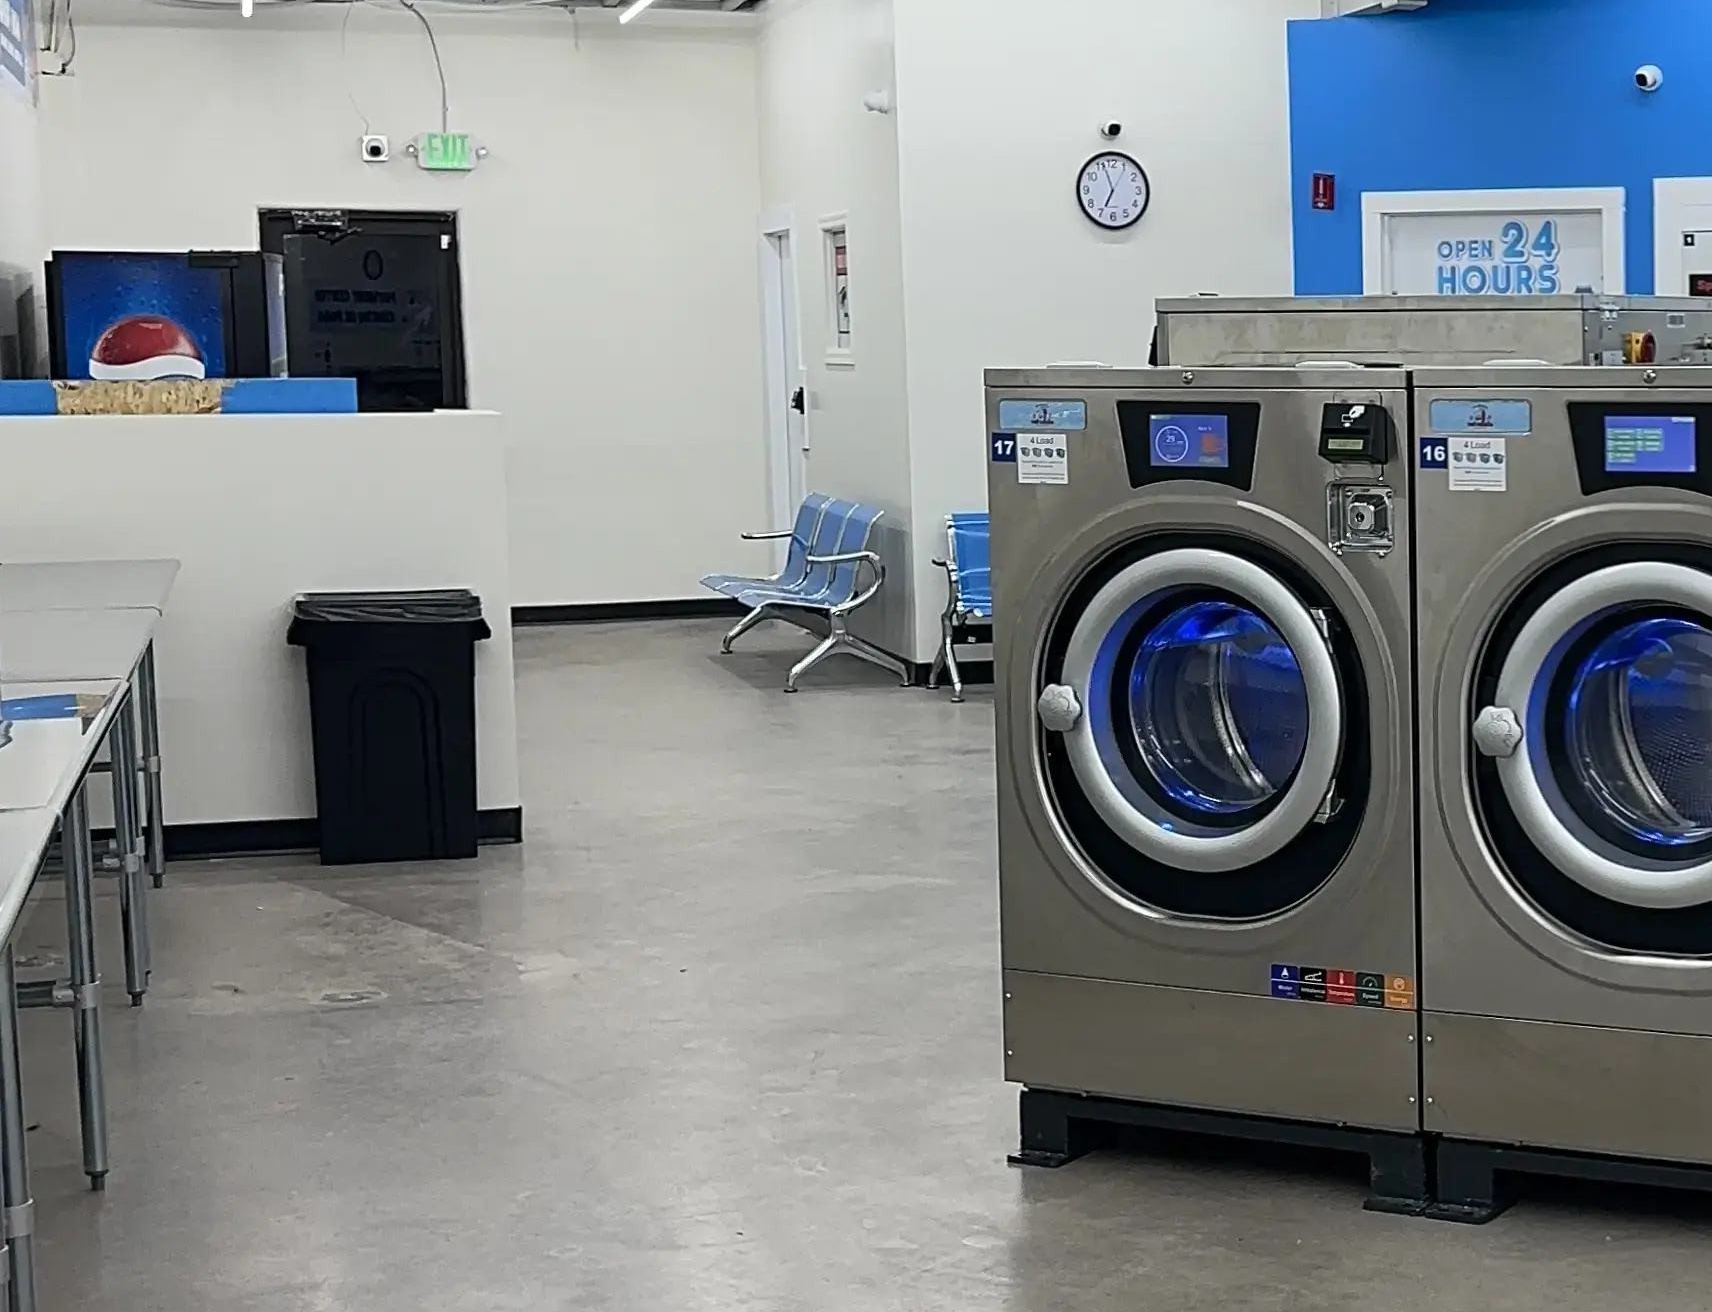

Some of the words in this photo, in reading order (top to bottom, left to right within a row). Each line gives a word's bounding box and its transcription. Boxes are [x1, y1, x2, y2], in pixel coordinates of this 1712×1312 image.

[427, 134, 469, 162] EXIT
[1106, 159, 1118, 169] 12
[1087, 171, 1098, 182] 10
[1130, 172, 1138, 182] 2
[1082, 185, 1090, 195] 9
[1135, 186, 1142, 196] 3
[1087, 198, 1095, 209] 8
[1131, 199, 1139, 208] 4
[1097, 208, 1105, 218] 7
[1109, 212, 1117, 222] 6
[1122, 208, 1130, 218] 5
[1437, 240, 1493, 259] OPEN
[1501, 220, 1558, 260] 24
[1437, 264, 1559, 294] HOURS
[1036, 437, 1054, 445] Load
[1470, 441, 1491, 449] Load
[994, 440, 1014, 455] 17
[1422, 445, 1446, 462] 16
